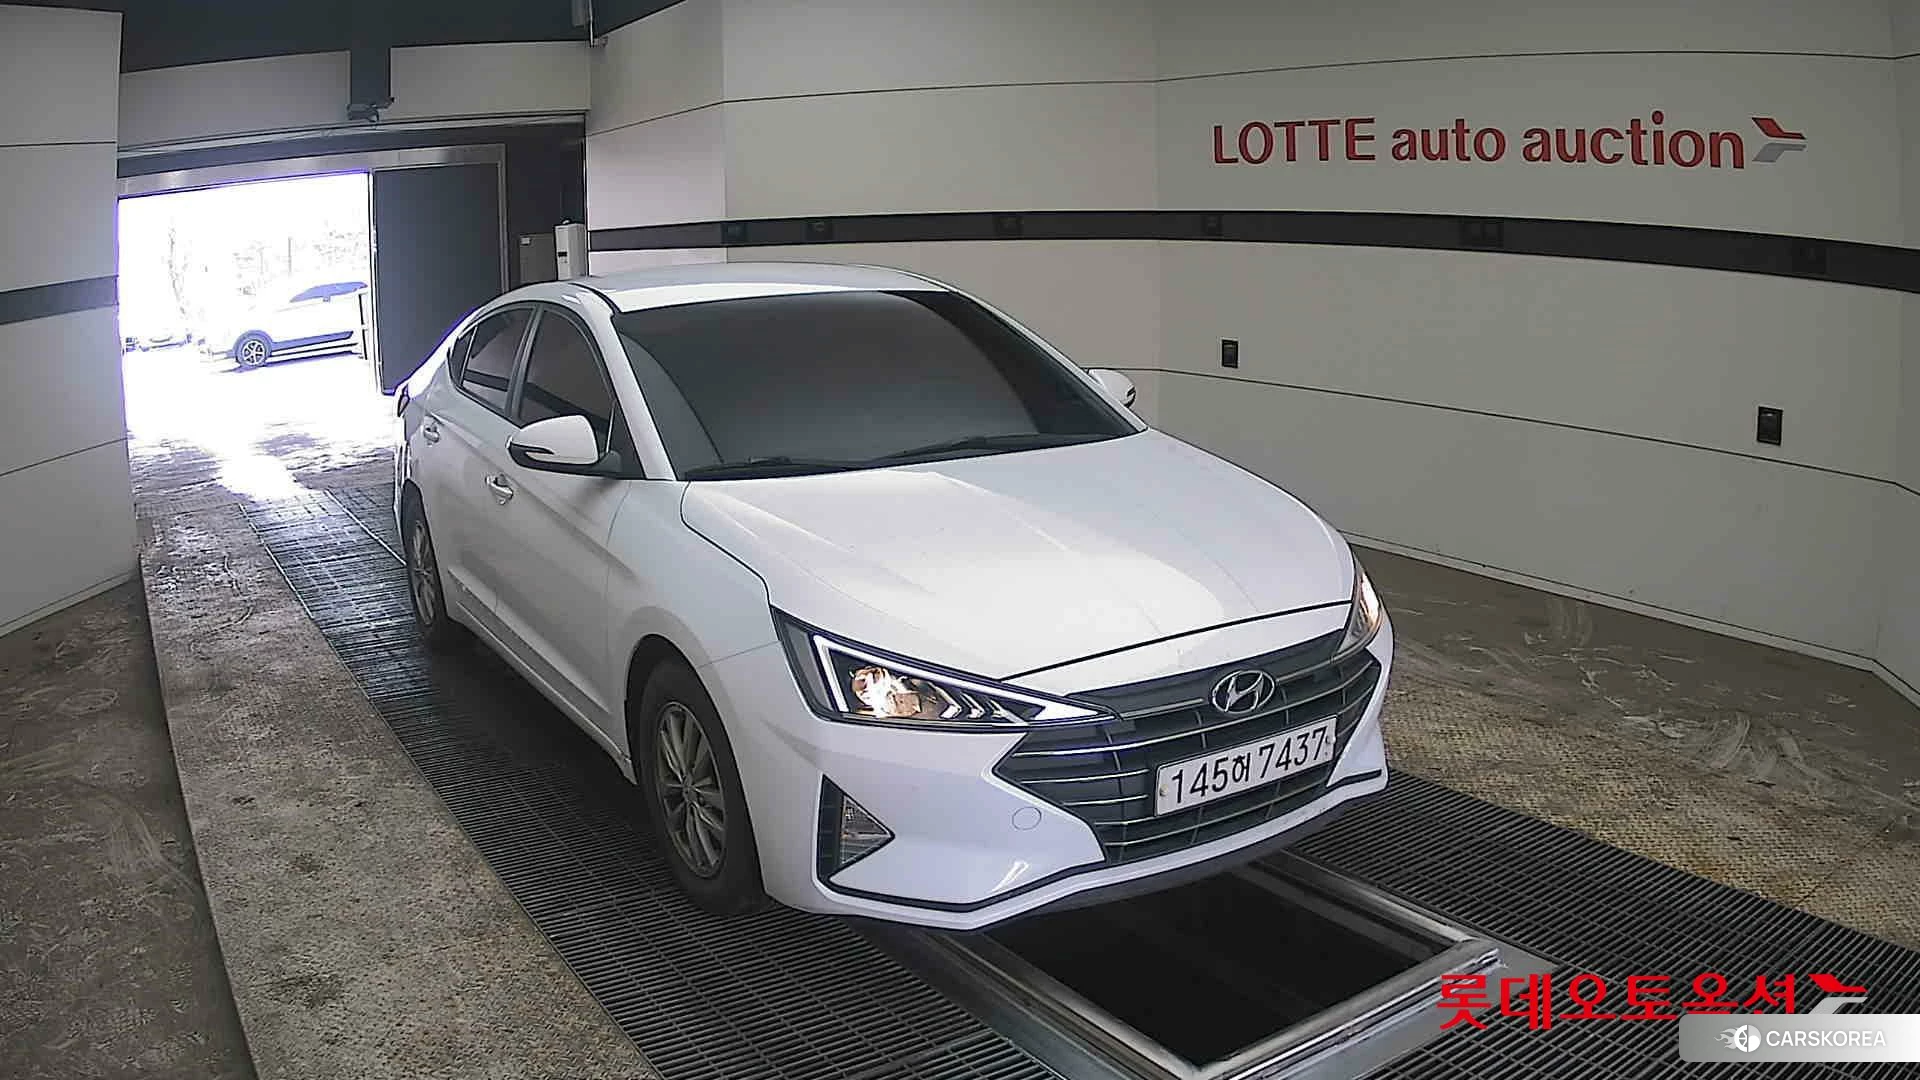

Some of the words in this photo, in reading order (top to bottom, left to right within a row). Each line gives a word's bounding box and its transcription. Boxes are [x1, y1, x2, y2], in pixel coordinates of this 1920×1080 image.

[1213, 116, 1377, 165] LOTTE
[1391, 117, 1507, 162] auto
[1522, 110, 1746, 169] auction
[1171, 751, 1251, 804] 145허
[1258, 726, 1329, 779] 7437
